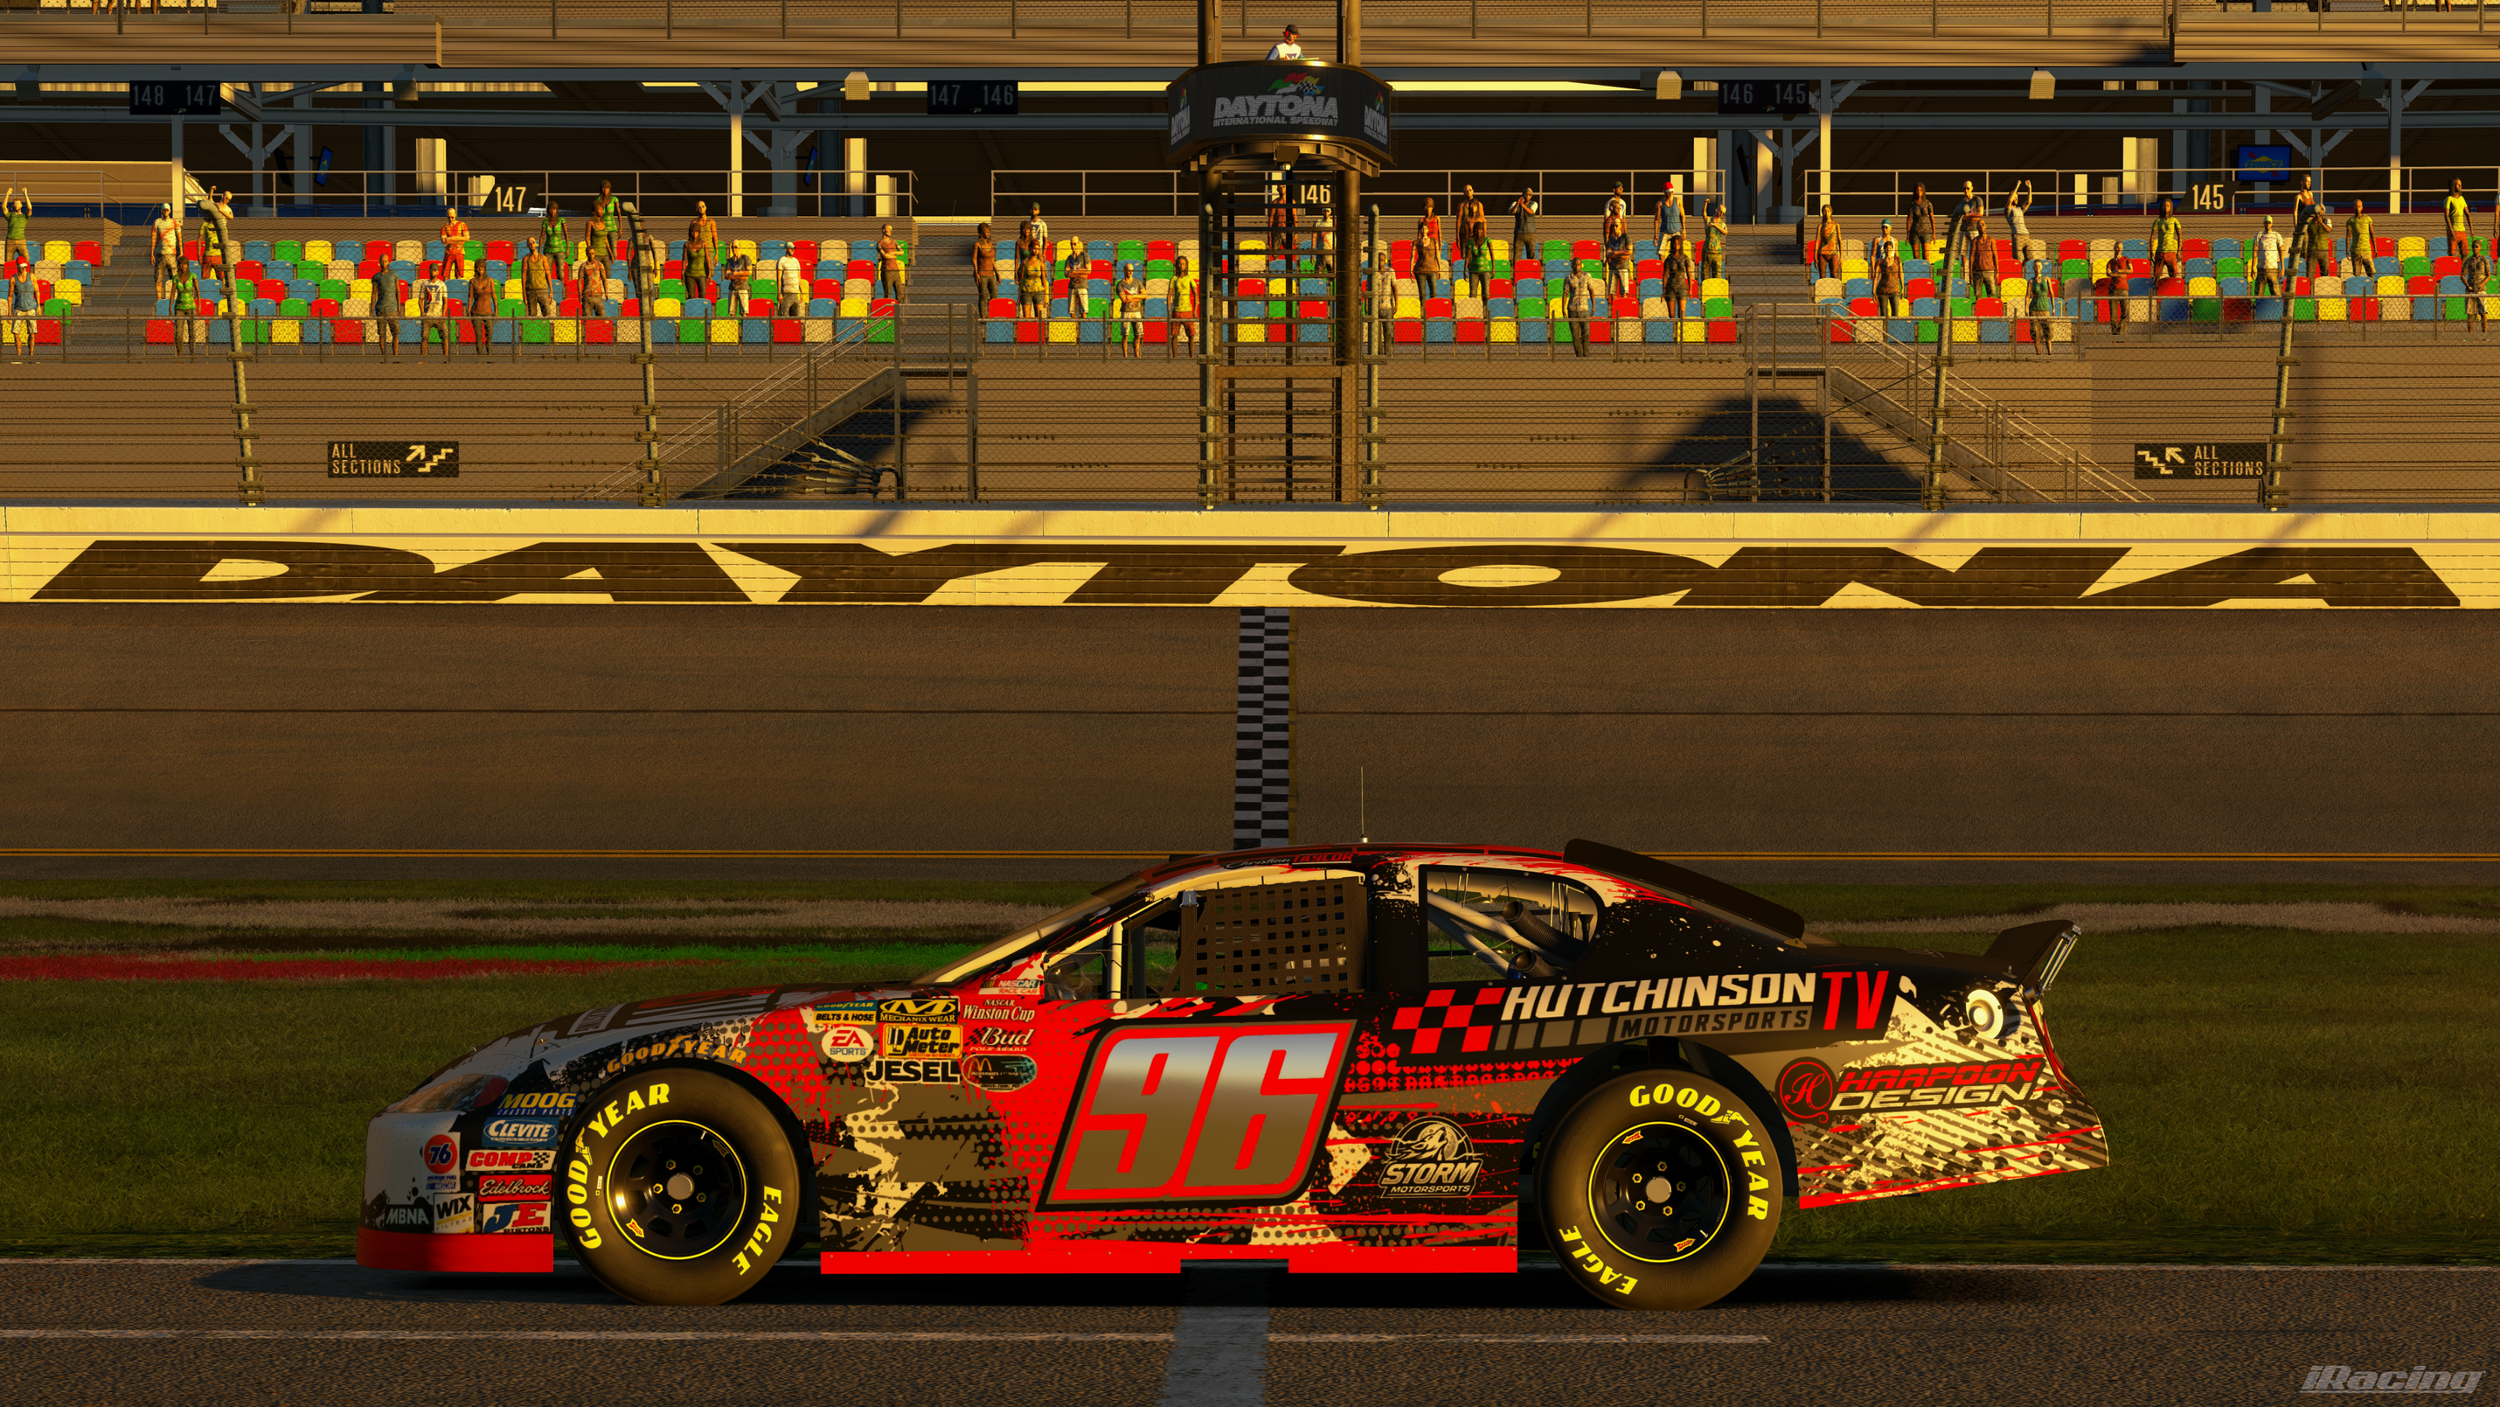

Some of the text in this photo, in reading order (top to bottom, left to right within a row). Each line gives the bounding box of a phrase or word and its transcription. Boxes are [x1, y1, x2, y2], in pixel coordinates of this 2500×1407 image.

[132, 84, 165, 106] 148
[185, 84, 217, 106] 147
[930, 84, 961, 106] 147
[982, 84, 1015, 106] 146
[1722, 83, 1754, 104] 146
[1774, 83, 1807, 104] 145
[1213, 95, 1339, 119] DAYTONA
[1213, 115, 1339, 127] INTERNATIONAL SPEEDWAY
[2245, 160, 2282, 169] SUNOCO
[495, 186, 527, 213] 147
[1299, 178, 1332, 205] 146
[2192, 184, 2224, 210] 145
[332, 443, 356, 458] ALL
[2194, 445, 2218, 460] ALL
[332, 459, 401, 474] SECTIONS
[2194, 461, 2263, 476] SECTIONS
[29, 540, 2461, 607] DAYTONA
[1293, 853, 1354, 863] TAYLOR
[998, 980, 1038, 989] NASCAR
[984, 999, 1015, 1007] NASCAR
[1501, 970, 1889, 1031] HUTCHINSON TV
[816, 1013, 875, 1022] BELTS & HOSE
[880, 1012, 956, 1023] MECHANIX WEAR
[962, 1004, 1036, 1023] Winston Cup
[906, 1027, 952, 1041] Auto
[1619, 1009, 1809, 1039] MOTORSPORTS
[830, 1030, 865, 1048] EA
[981, 1027, 1035, 1047] Bud
[829, 1047, 866, 1056] SPORTS
[903, 1041, 960, 1054] Meter
[865, 1059, 960, 1084] JESEL
[1838, 1061, 2042, 1092] HARPOON
[498, 1092, 577, 1109] MOOG
[1829, 1083, 2033, 1111] DESIGN
[497, 1108, 573, 1116] CHASSIS PARTS
[1056, 1026, 1348, 1198] 96
[488, 1119, 553, 1138] CLEVITE
[428, 1142, 452, 1166] 76
[469, 1151, 534, 1168] COMP
[1381, 1162, 1480, 1185] STORM
[479, 1178, 550, 1197] Edelbrock
[1390, 1185, 1472, 1194] MOTORSPORTS
[386, 1208, 431, 1225] MBNA
[436, 1194, 473, 1220] WIX
[483, 1203, 548, 1234] JE
[731, 1184, 783, 1276] EAGLE
[1558, 1224, 1639, 1296] EAGLE
